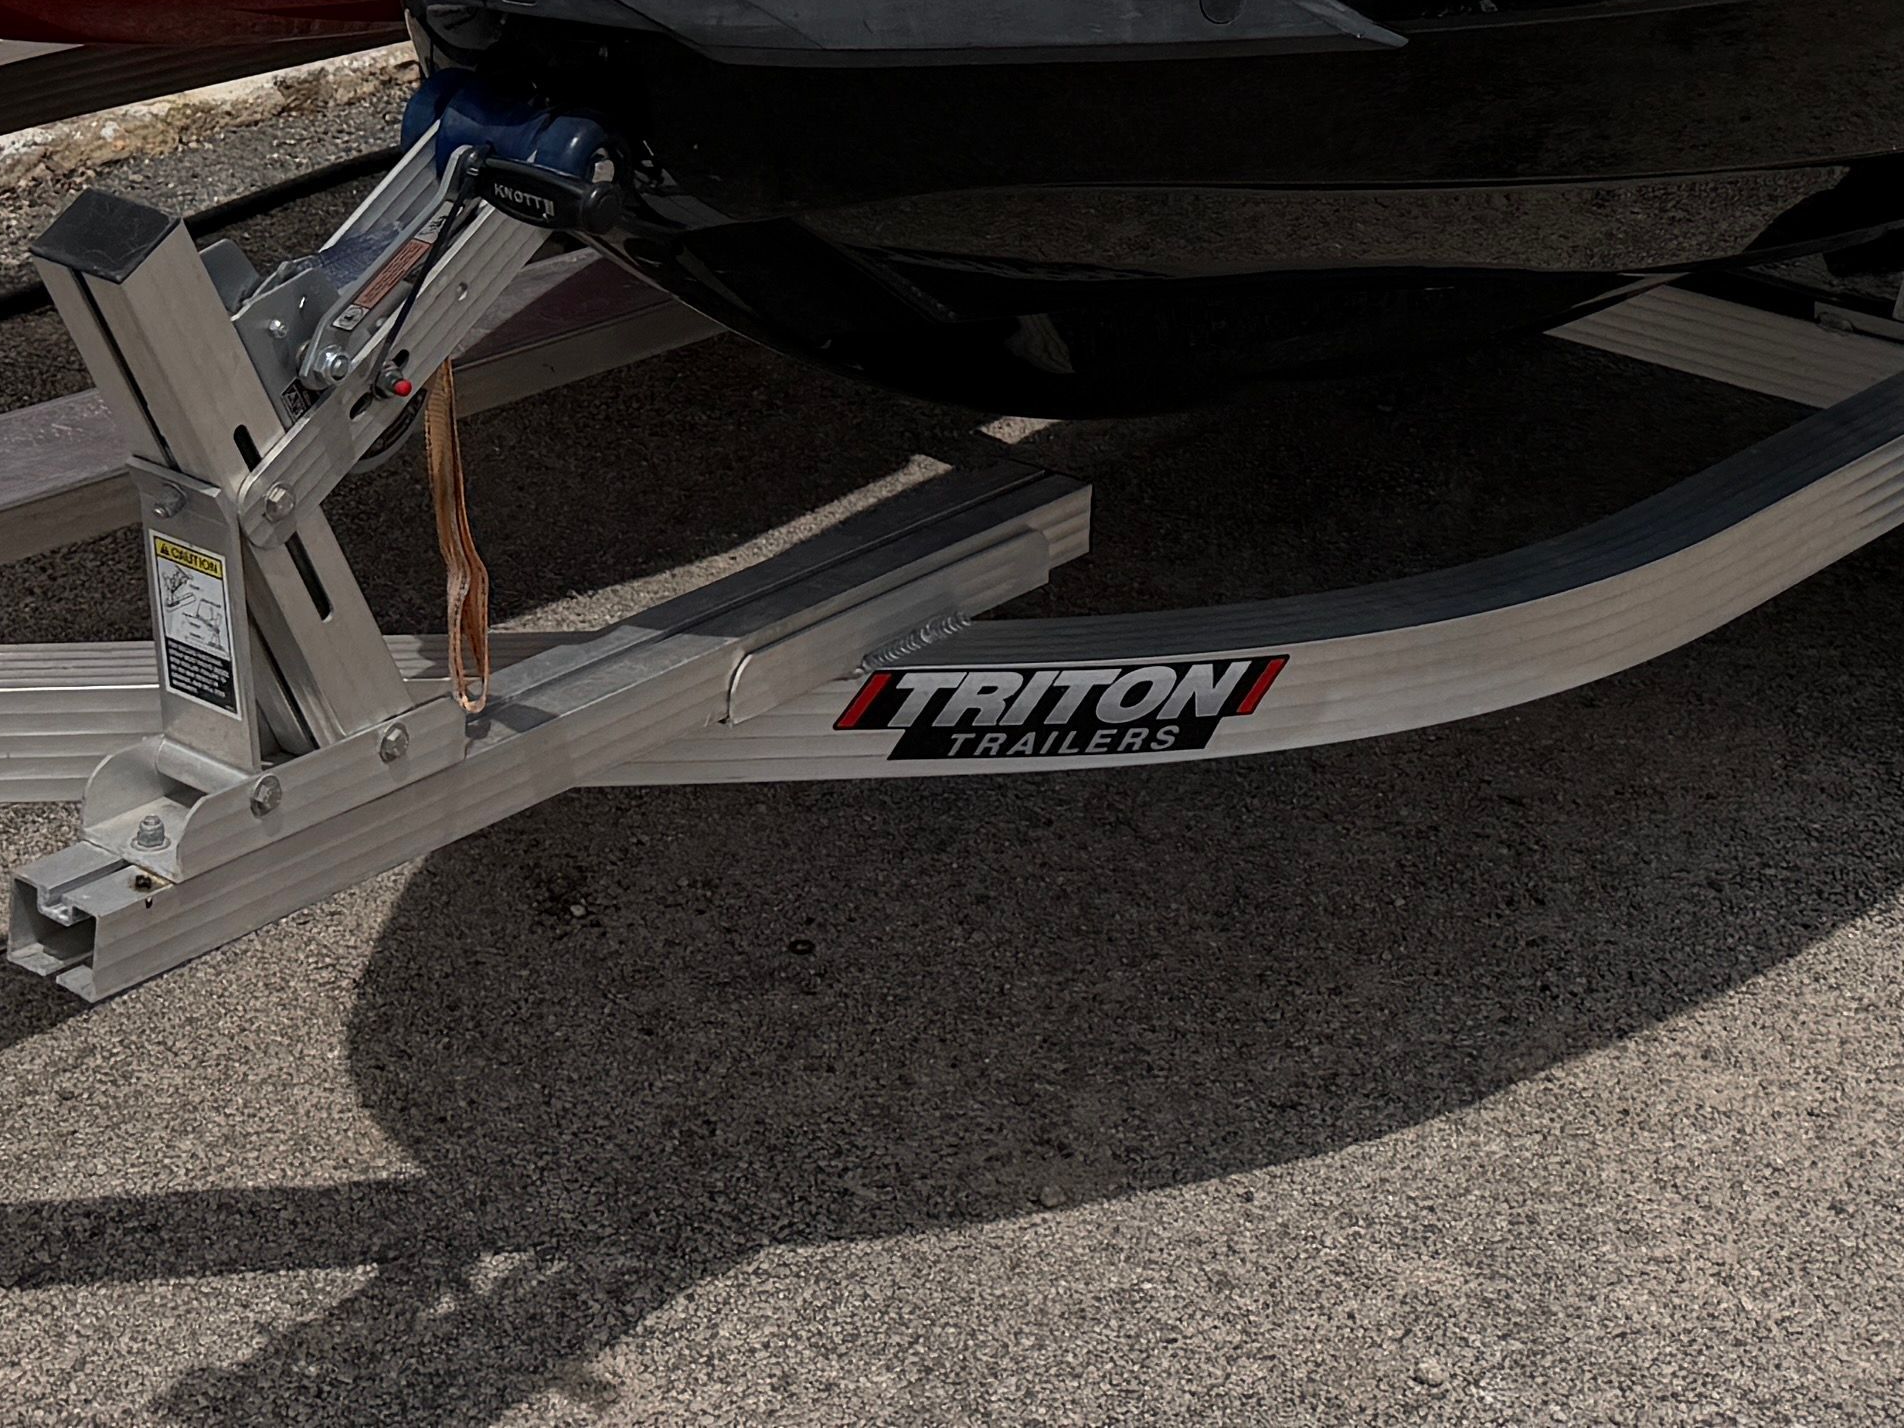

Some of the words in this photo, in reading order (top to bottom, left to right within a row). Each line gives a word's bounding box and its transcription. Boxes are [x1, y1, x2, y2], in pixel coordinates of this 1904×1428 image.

[494, 183, 542, 209] KNOTT
[171, 547, 218, 574] CAUTION
[888, 660, 1252, 727] TRITON
[947, 725, 1180, 757] TRAILERS
